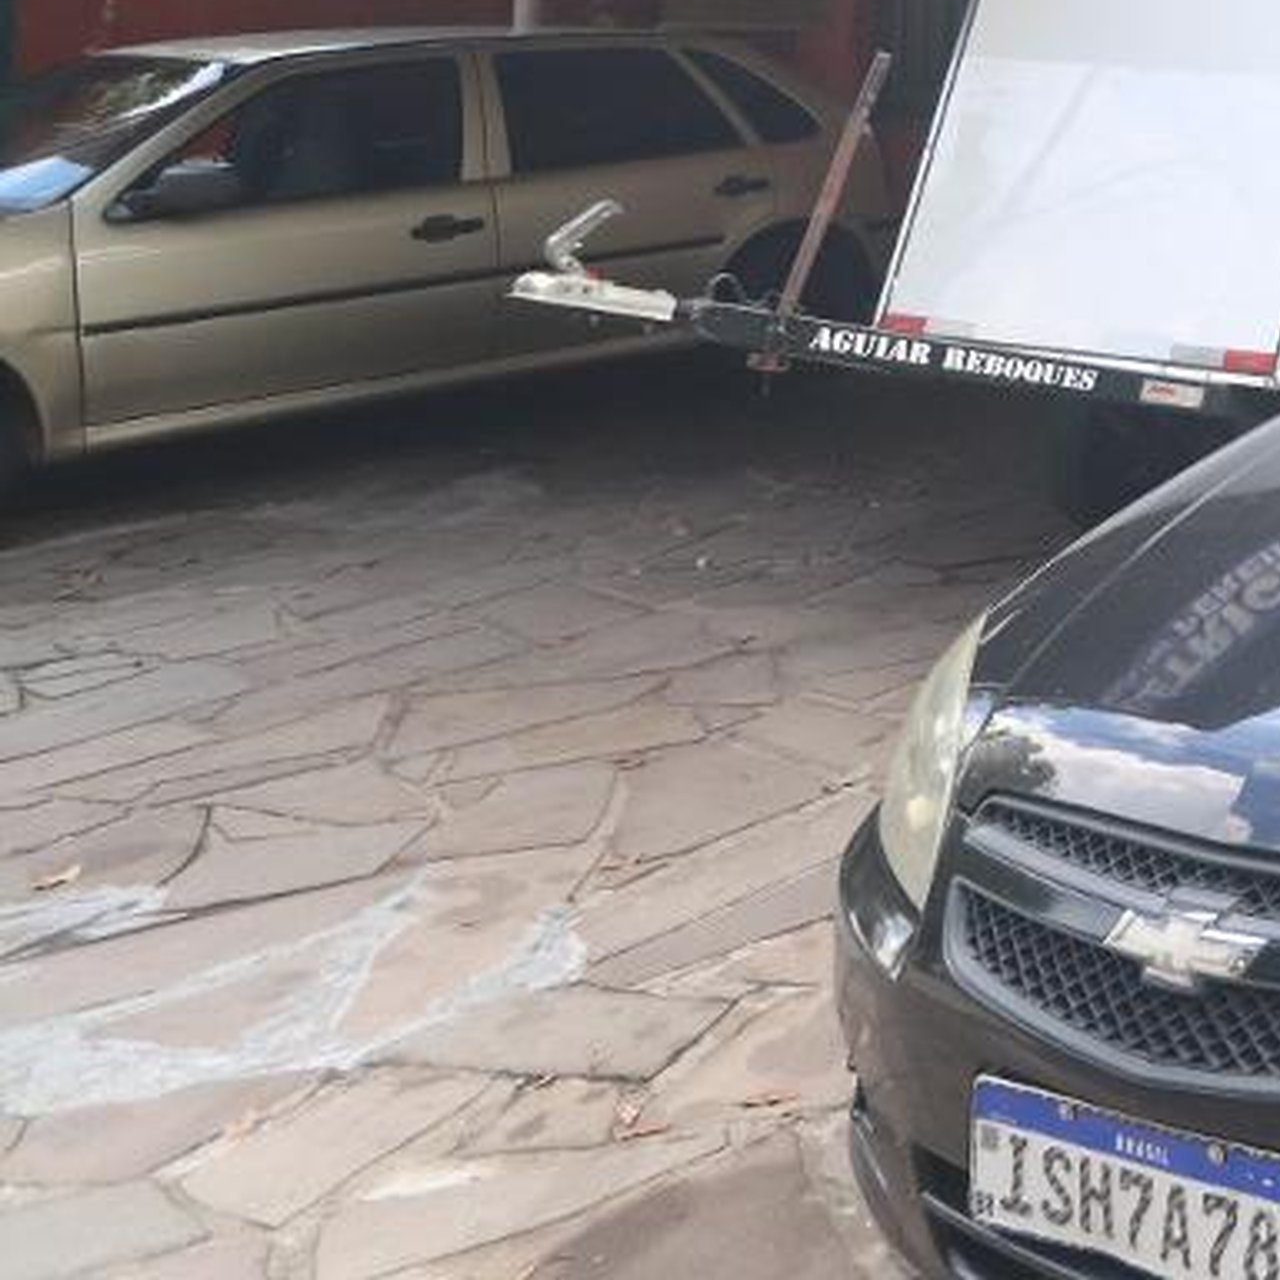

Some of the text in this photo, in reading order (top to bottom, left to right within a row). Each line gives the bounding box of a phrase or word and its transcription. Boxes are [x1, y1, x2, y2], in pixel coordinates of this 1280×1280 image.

[808, 326, 1099, 392] AGUIAR REBOQUES
[1115, 1133, 1170, 1166] BRASIL
[1001, 1134, 1280, 1280] ISH7A78
